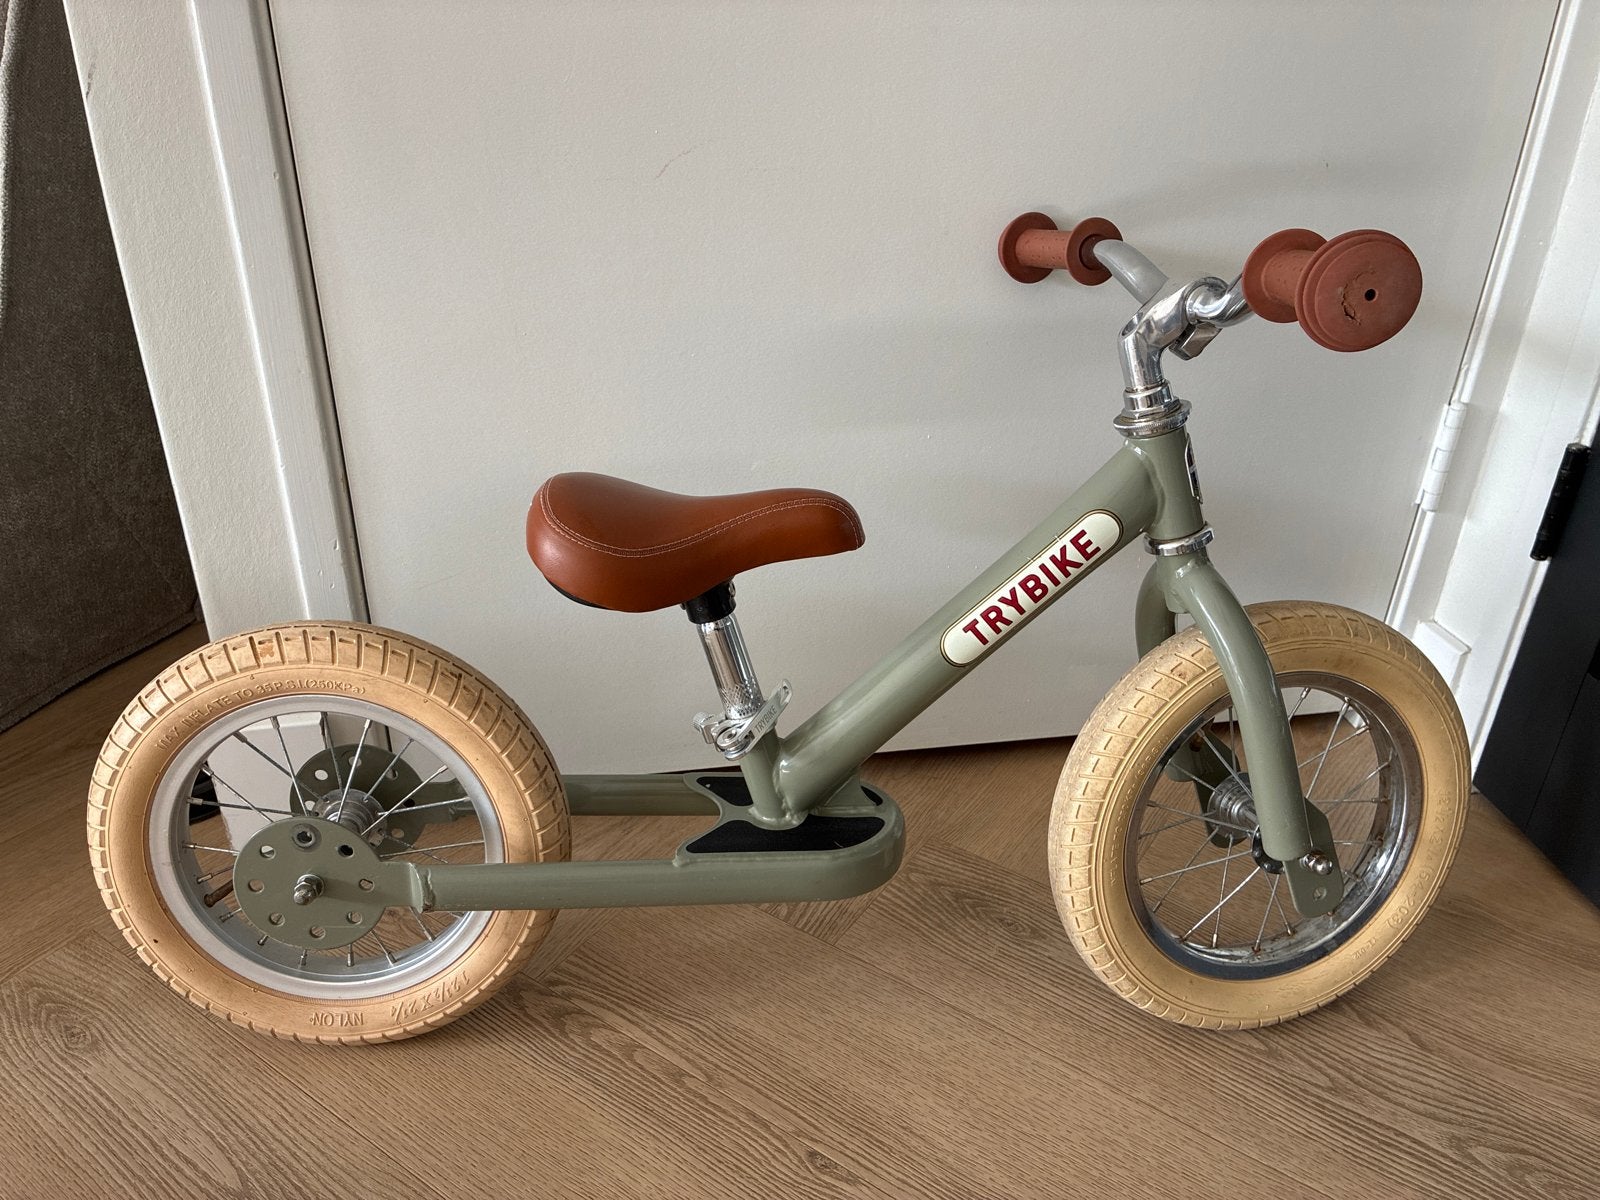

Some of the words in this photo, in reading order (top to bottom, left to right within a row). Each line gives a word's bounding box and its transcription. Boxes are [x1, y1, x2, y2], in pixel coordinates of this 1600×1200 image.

[962, 529, 1102, 646] TRYBIKE
[181, 695, 234, 730] INFLATE
[234, 687, 254, 702] TO
[755, 704, 778, 734] TRYBIKE
[311, 1010, 364, 1027] NYLON
